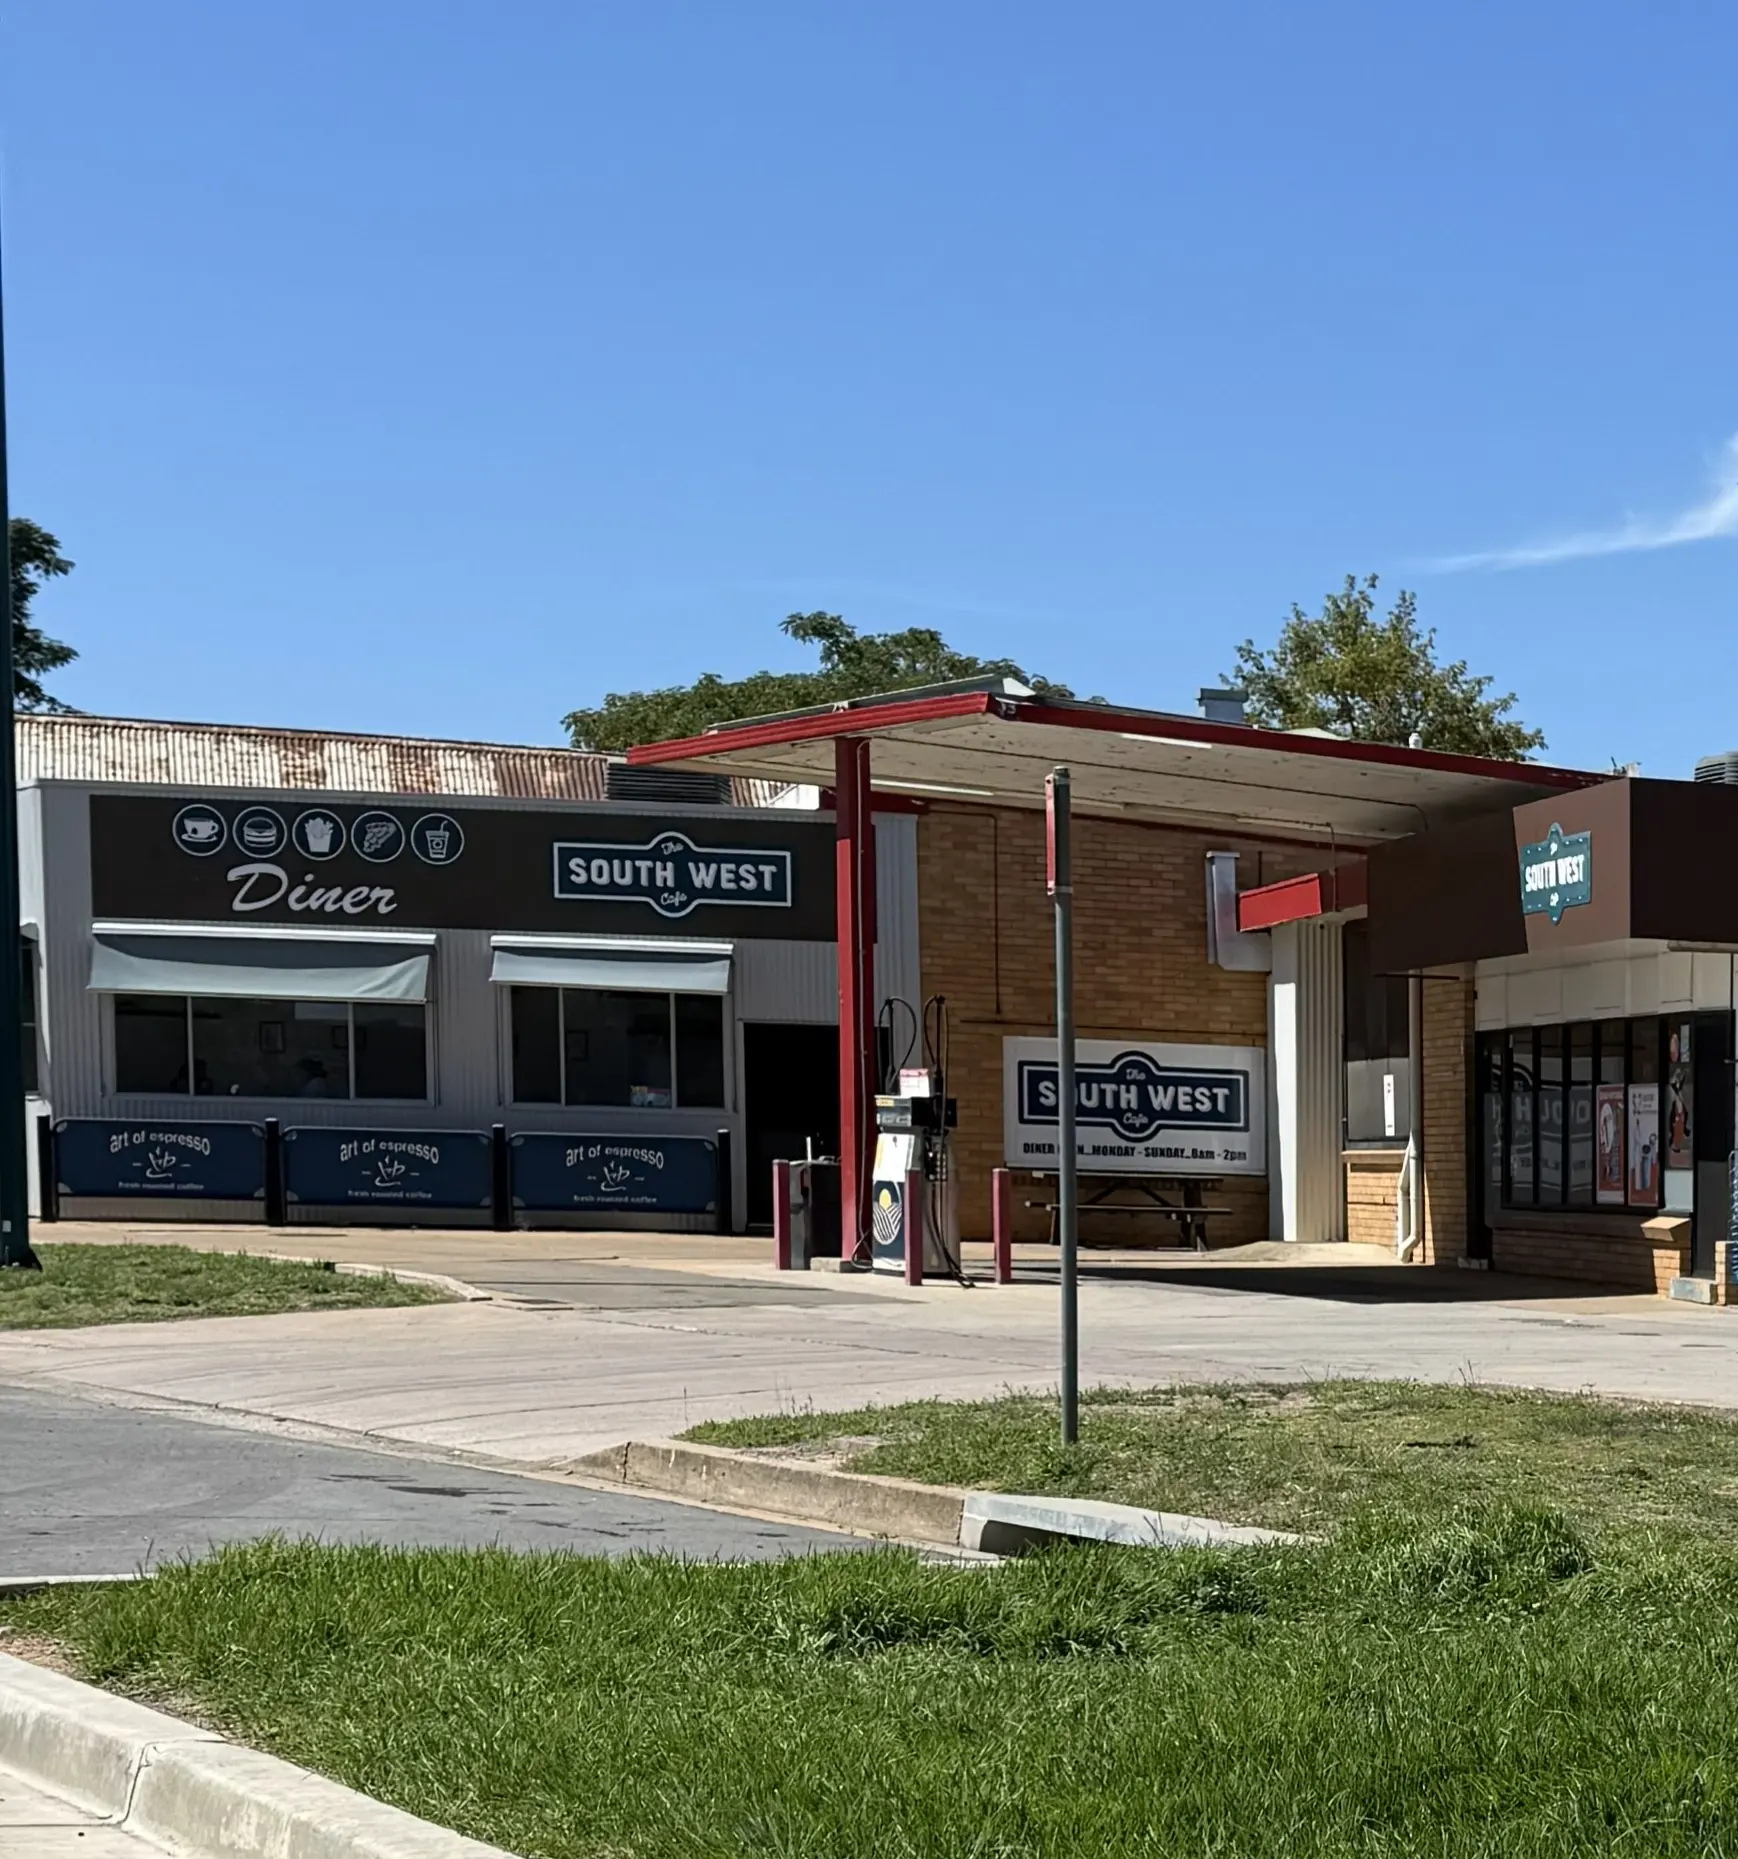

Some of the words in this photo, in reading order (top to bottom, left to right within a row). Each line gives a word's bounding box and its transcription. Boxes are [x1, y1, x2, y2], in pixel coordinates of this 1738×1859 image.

[568, 857, 675, 888] SOUTH
[688, 861, 778, 891] WEST
[1557, 854, 1585, 885] WEST
[226, 863, 398, 914] Diner
[1038, 1080, 1138, 1111] SUTH
[1147, 1084, 1230, 1114] WEST
[110, 1131, 129, 1153] art
[132, 1130, 146, 1144] of
[149, 1132, 211, 1156] espresso
[340, 1139, 358, 1162] art
[362, 1138, 376, 1153] of
[379, 1140, 439, 1164] espresso
[565, 1145, 584, 1167] art
[588, 1144, 602, 1158] of
[605, 1146, 665, 1171] espresso
[1023, 1142, 1056, 1154] DINER
